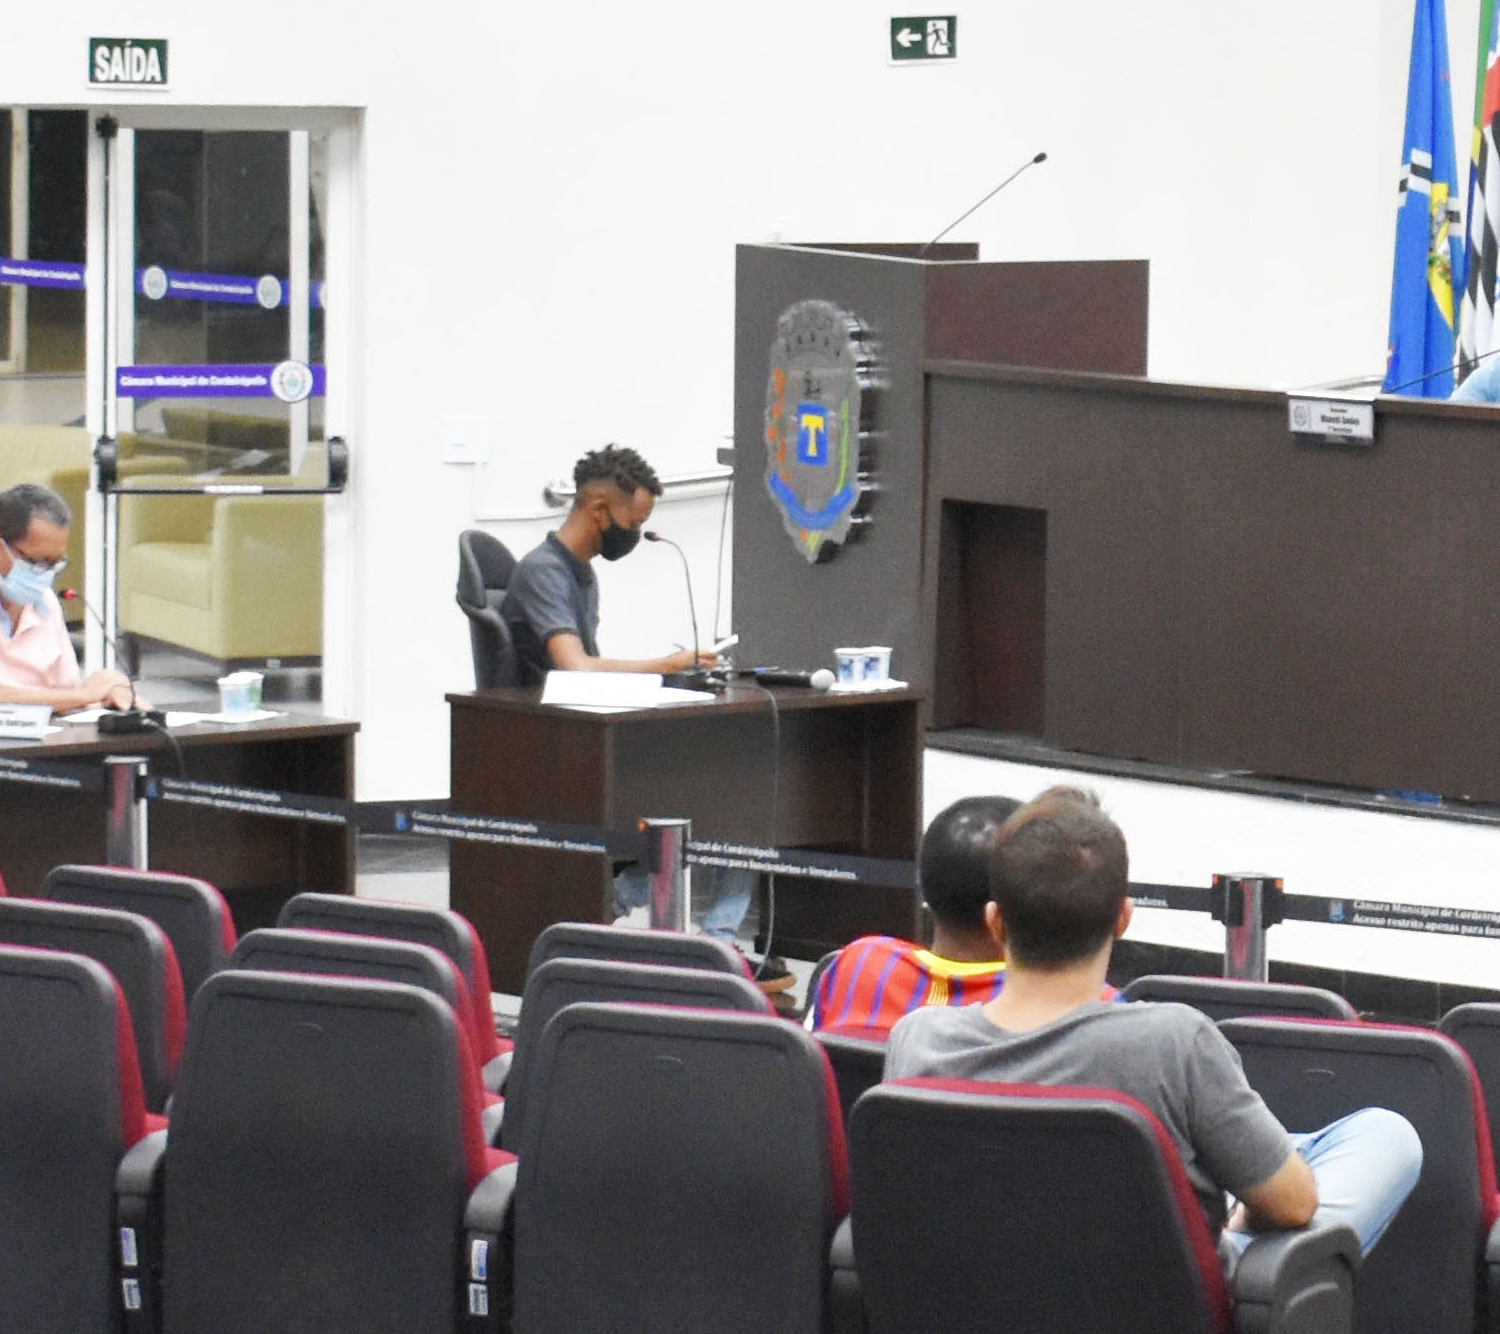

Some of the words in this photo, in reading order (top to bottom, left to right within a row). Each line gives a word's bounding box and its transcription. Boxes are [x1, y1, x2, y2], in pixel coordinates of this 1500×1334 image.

[94, 39, 162, 82] SAÍDA
[1353, 899, 1390, 912] Câmara
[1391, 902, 1440, 917] Municipal
[1352, 913, 1386, 925] Acesso
[1387, 917, 1424, 929] restrito
[1425, 921, 1459, 932] apenas
[1460, 925, 1483, 934] para
